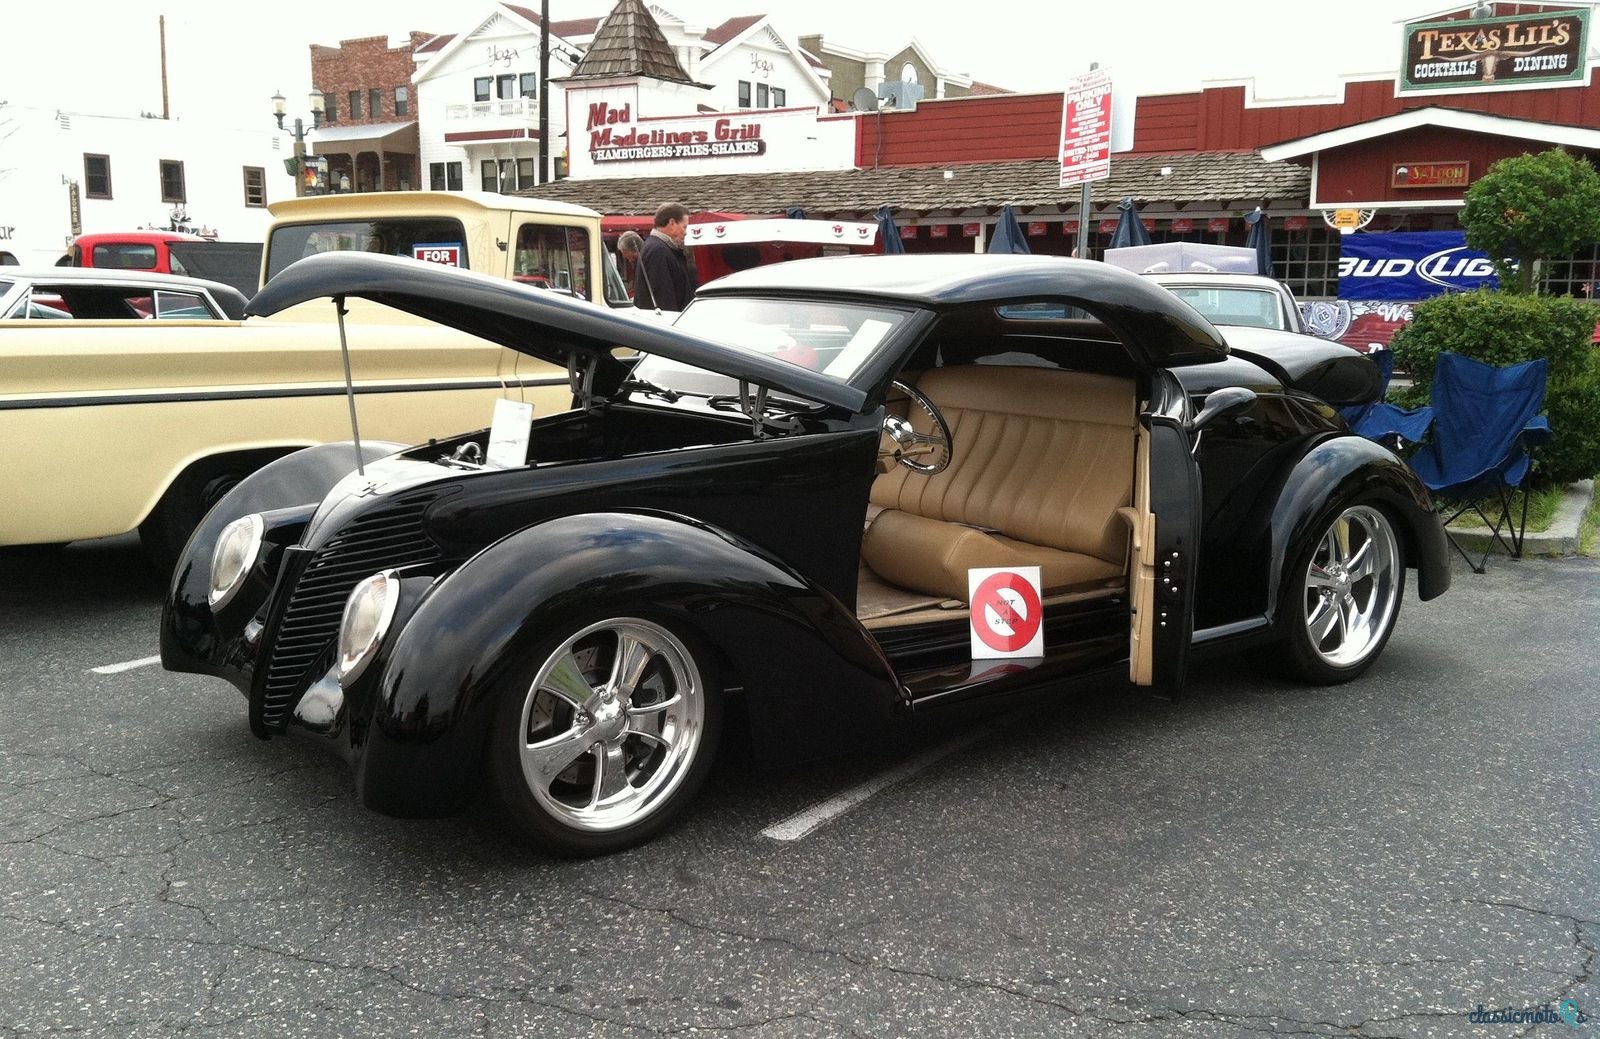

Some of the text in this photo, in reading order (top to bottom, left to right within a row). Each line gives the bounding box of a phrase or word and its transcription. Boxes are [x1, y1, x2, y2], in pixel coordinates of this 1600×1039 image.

[1417, 19, 1571, 60] TEXAS LIL'S
[1414, 54, 1568, 78] COCKTAILS DINING
[1067, 84, 1111, 104] PARKING
[1075, 95, 1104, 111] ONLY
[586, 102, 630, 131] Mad
[589, 118, 762, 152] Madeline's Grill
[423, 250, 450, 262] FOR
[1338, 257, 1415, 277] BUD
